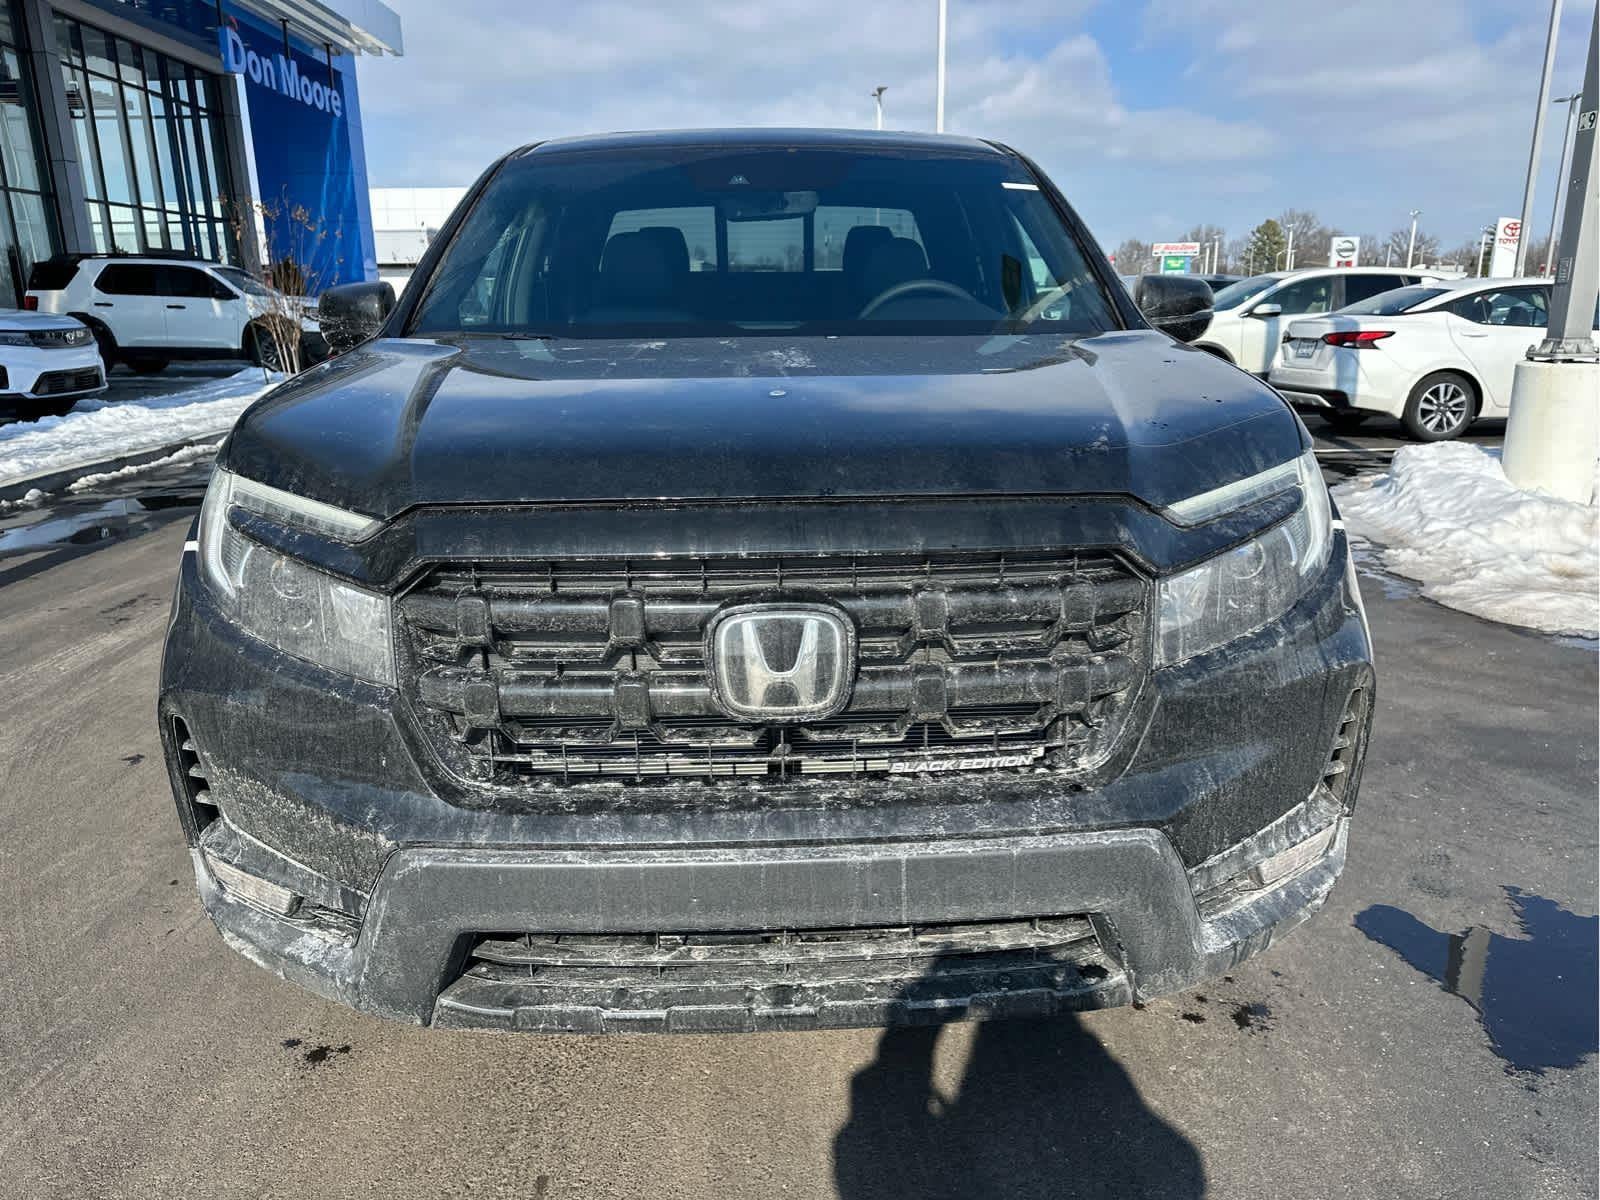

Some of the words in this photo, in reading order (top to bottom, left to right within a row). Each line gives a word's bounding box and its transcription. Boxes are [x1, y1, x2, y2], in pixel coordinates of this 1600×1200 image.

[225, 27, 277, 90] Don
[278, 54, 342, 117] Moore
[889, 759, 957, 773] BLACK
[958, 755, 1035, 770] EDITION
